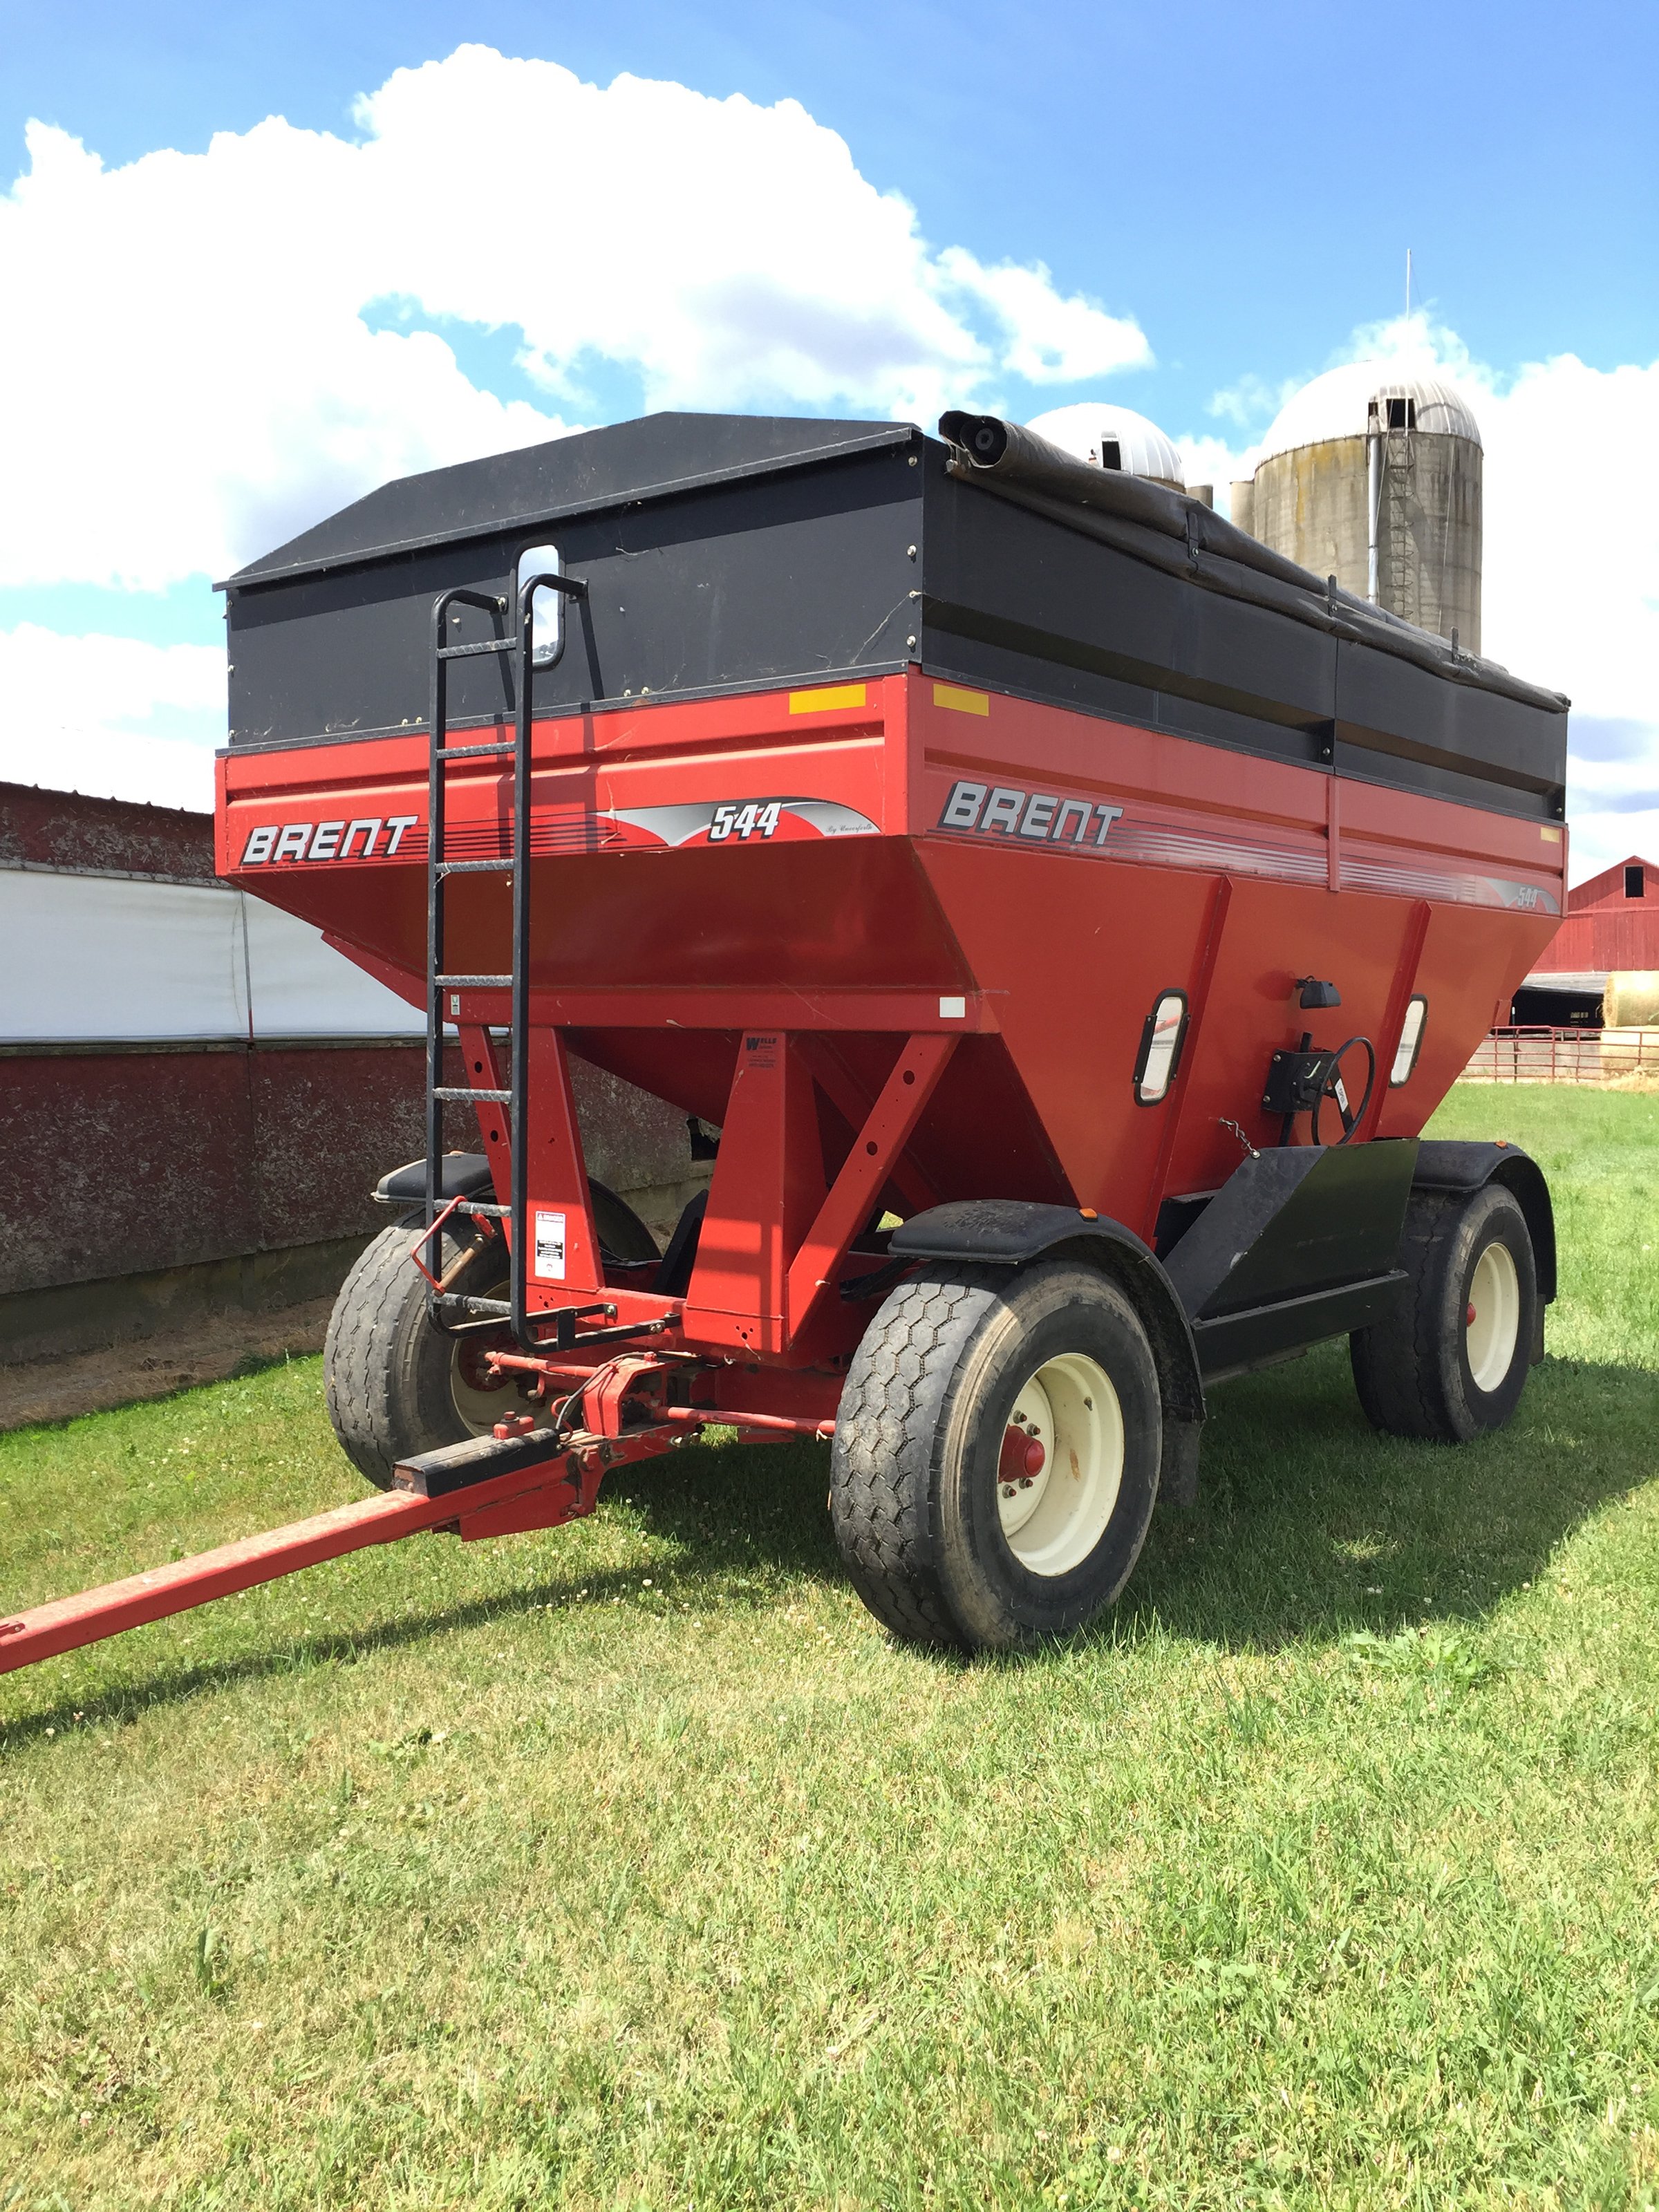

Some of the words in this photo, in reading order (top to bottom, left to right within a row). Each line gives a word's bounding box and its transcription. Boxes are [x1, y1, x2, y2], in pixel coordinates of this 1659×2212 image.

[709, 803, 782, 841] 544
[939, 780, 1124, 846] BRENT
[241, 815, 419, 864] BRENT
[1517, 887, 1538, 908] 544
